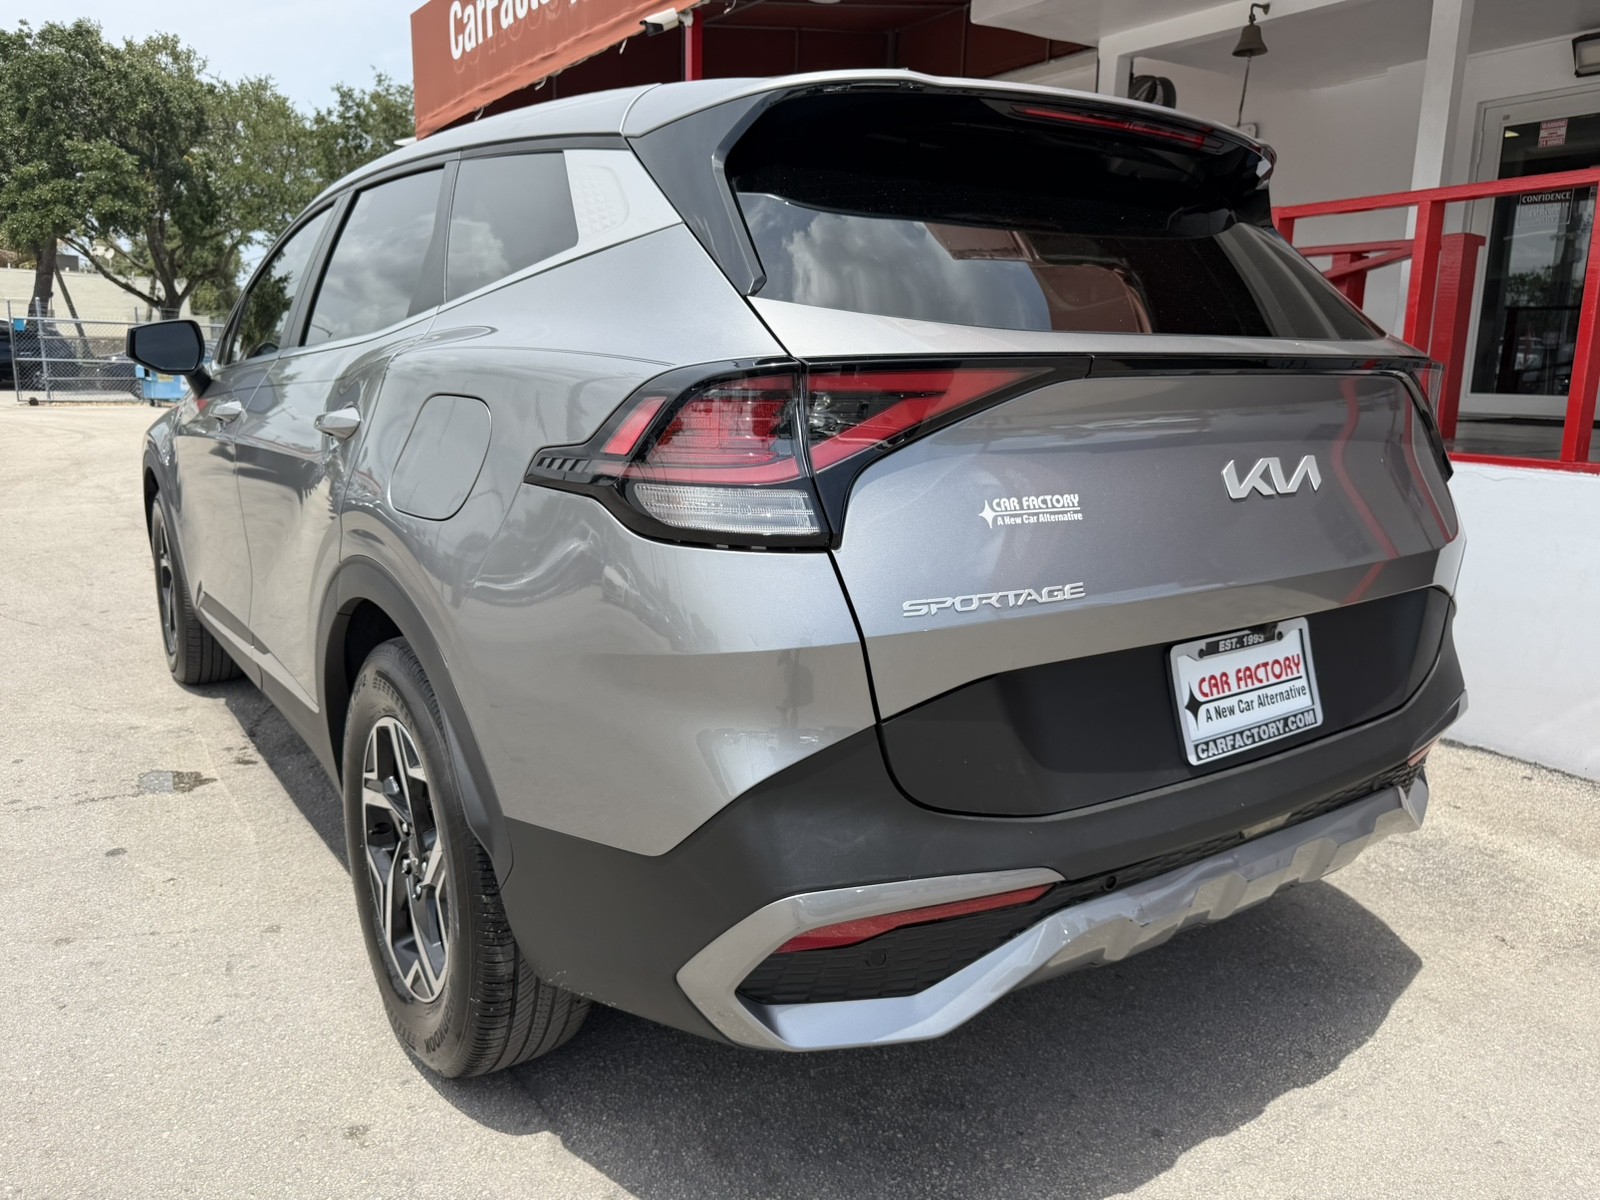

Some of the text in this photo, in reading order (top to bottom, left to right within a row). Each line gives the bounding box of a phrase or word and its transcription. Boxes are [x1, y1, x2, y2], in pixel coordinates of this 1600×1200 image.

[1522, 191, 1571, 203] CONFIDENCE
[1221, 454, 1322, 500] KIA
[992, 493, 1079, 511] CAR FACTORY
[997, 511, 1083, 526] A New Car Alternative
[902, 581, 1087, 617] SPORTAGE
[1218, 638, 1240, 652] EST.
[1198, 653, 1301, 698] CAR FACTORY
[1205, 684, 1307, 723] A New Car Alternative
[1196, 711, 1316, 759] CARFACTORY.COM
